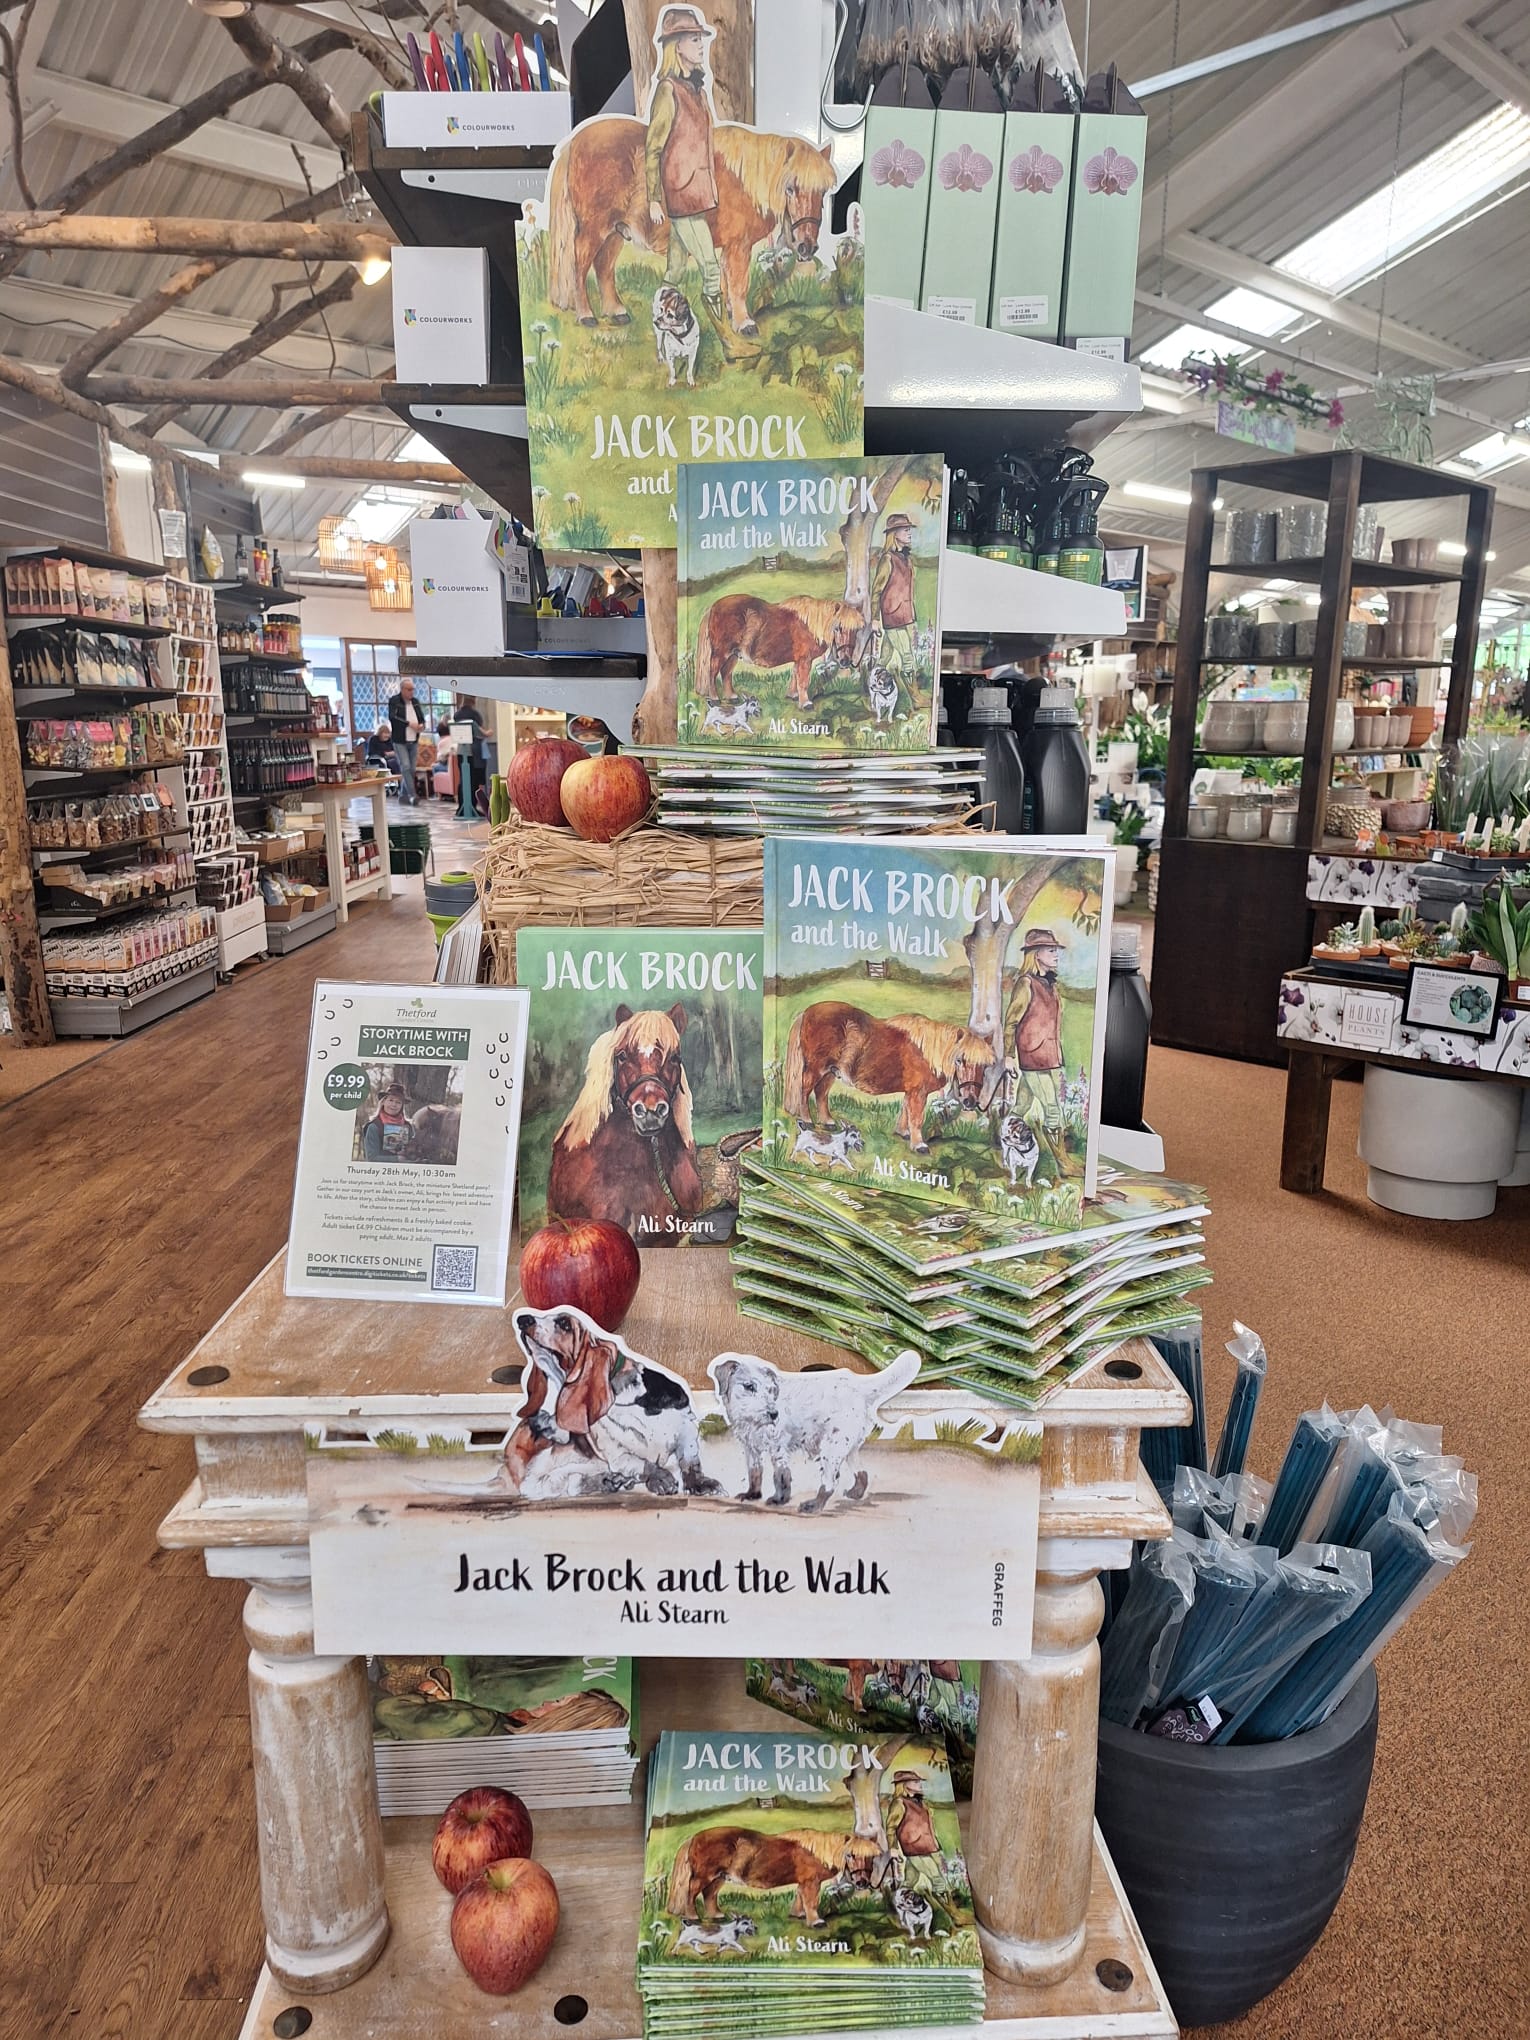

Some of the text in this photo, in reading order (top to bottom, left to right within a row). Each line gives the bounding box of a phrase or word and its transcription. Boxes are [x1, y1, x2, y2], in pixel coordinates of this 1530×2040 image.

[591, 415, 808, 459] JACK BROCK
[627, 469, 673, 495] and
[698, 480, 768, 520] JACK
[777, 476, 880, 515] BROCK
[700, 522, 828, 549] and the Walk
[769, 718, 830, 735] Ali Stearn
[788, 864, 1014, 924] JACK BROCK
[791, 920, 948, 958] and the Walk
[542, 950, 757, 991] JACK BROCK
[396, 1008, 438, 1018] Thetford
[1350, 1004, 1388, 1024] HOUSE
[362, 1028, 468, 1041] STORYTIME WITH
[1349, 1024, 1384, 1036] PLANTS
[373, 1045, 454, 1057] JACK BROCK
[328, 1075, 365, 1088] £9.99
[347, 1166, 379, 1176] Thursday
[382, 1168, 400, 1176] 28th
[423, 1169, 456, 1178] 10:30am
[872, 1156, 950, 1188] Ali Stearn
[415, 1218, 434, 1226] freshly
[638, 1214, 717, 1233] Ali Stearn
[307, 1253, 422, 1267] BOOK TICKETS ONLINE
[453, 1552, 892, 1595] Jack Brock and the Walk
[992, 1561, 1006, 1628] GRAFFEG
[619, 1599, 730, 1626] Ali Stearn
[826, 1709, 843, 1728] Ali
[682, 1743, 883, 1770] JACK BROCK
[683, 1772, 832, 1793] and the Walk
[768, 1935, 851, 1952] Ali Stearn
